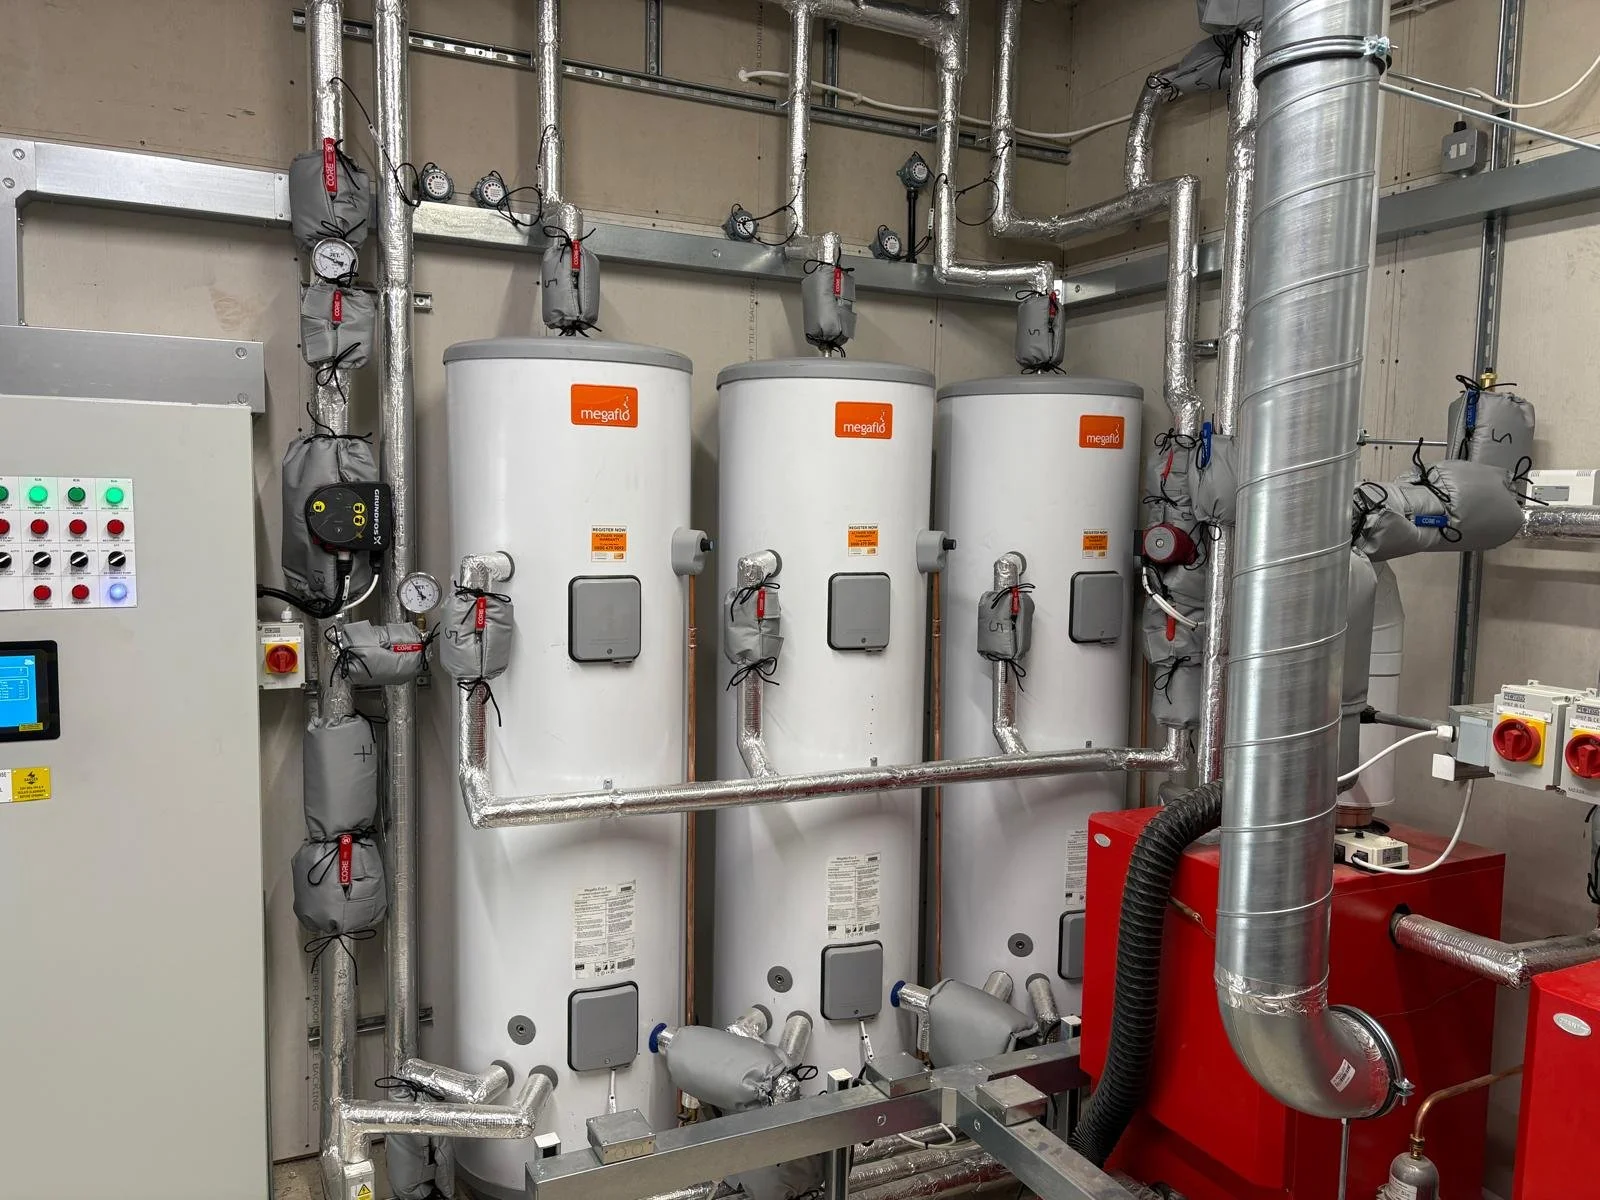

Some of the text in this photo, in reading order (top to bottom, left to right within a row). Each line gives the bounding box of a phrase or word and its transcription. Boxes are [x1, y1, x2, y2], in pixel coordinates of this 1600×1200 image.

[326, 163, 335, 187] CORE
[580, 408, 631, 423] megaflo
[843, 421, 886, 435] megaflo
[1086, 432, 1120, 446] megaflo
[341, 860, 349, 882] CORE
